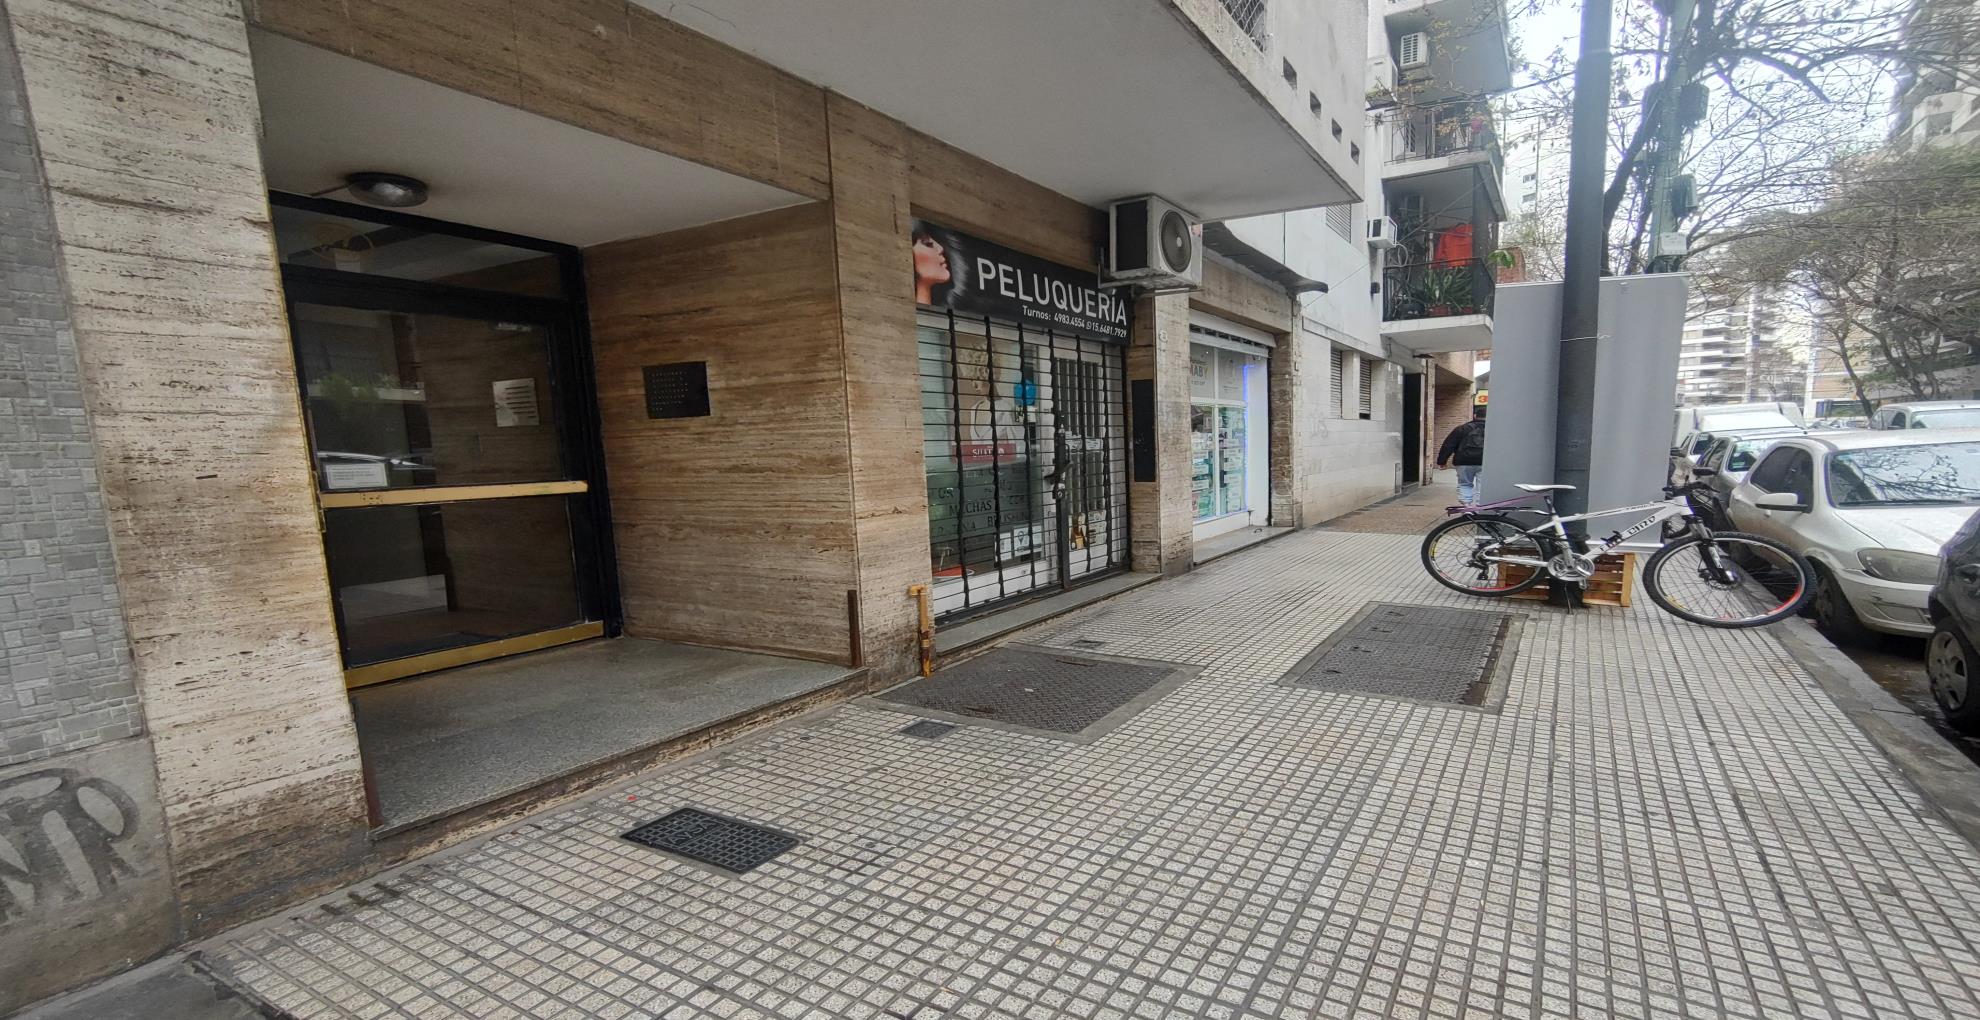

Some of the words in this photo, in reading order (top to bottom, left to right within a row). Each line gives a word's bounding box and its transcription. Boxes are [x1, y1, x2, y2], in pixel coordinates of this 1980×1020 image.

[977, 257, 1127, 325] PELUQUERÍA
[1022, 304, 1051, 321] Turnos:
[949, 499, 992, 517] MCHAS
